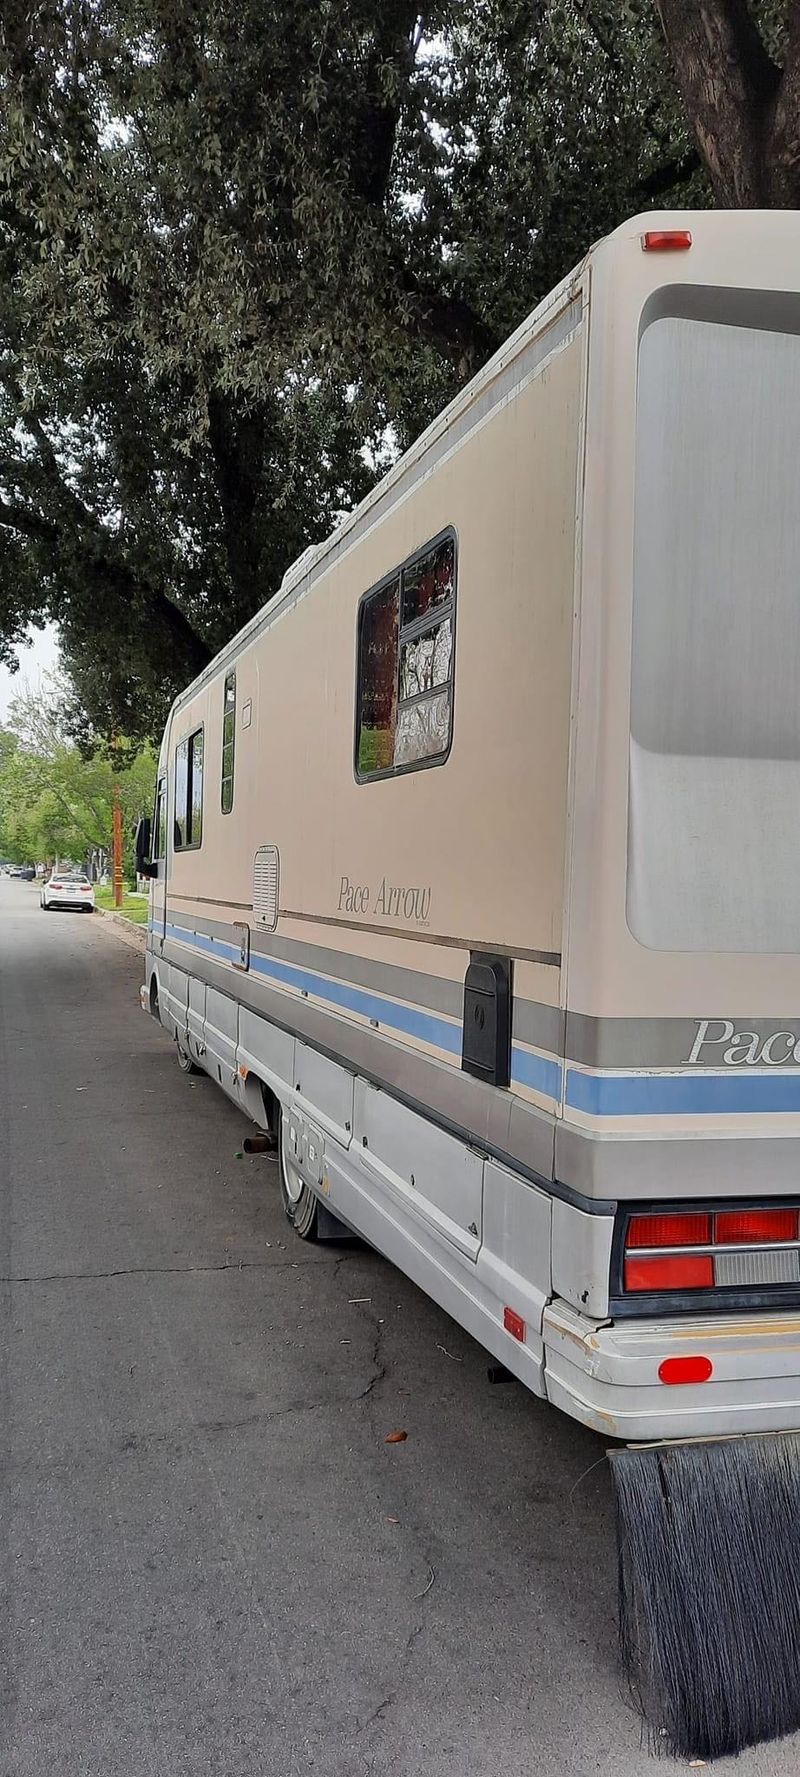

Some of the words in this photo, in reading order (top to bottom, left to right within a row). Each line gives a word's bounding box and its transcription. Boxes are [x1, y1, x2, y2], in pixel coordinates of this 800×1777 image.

[337, 876, 370, 914] Pace
[373, 876, 432, 921] Arrow
[680, 1019, 800, 1066] Pac
